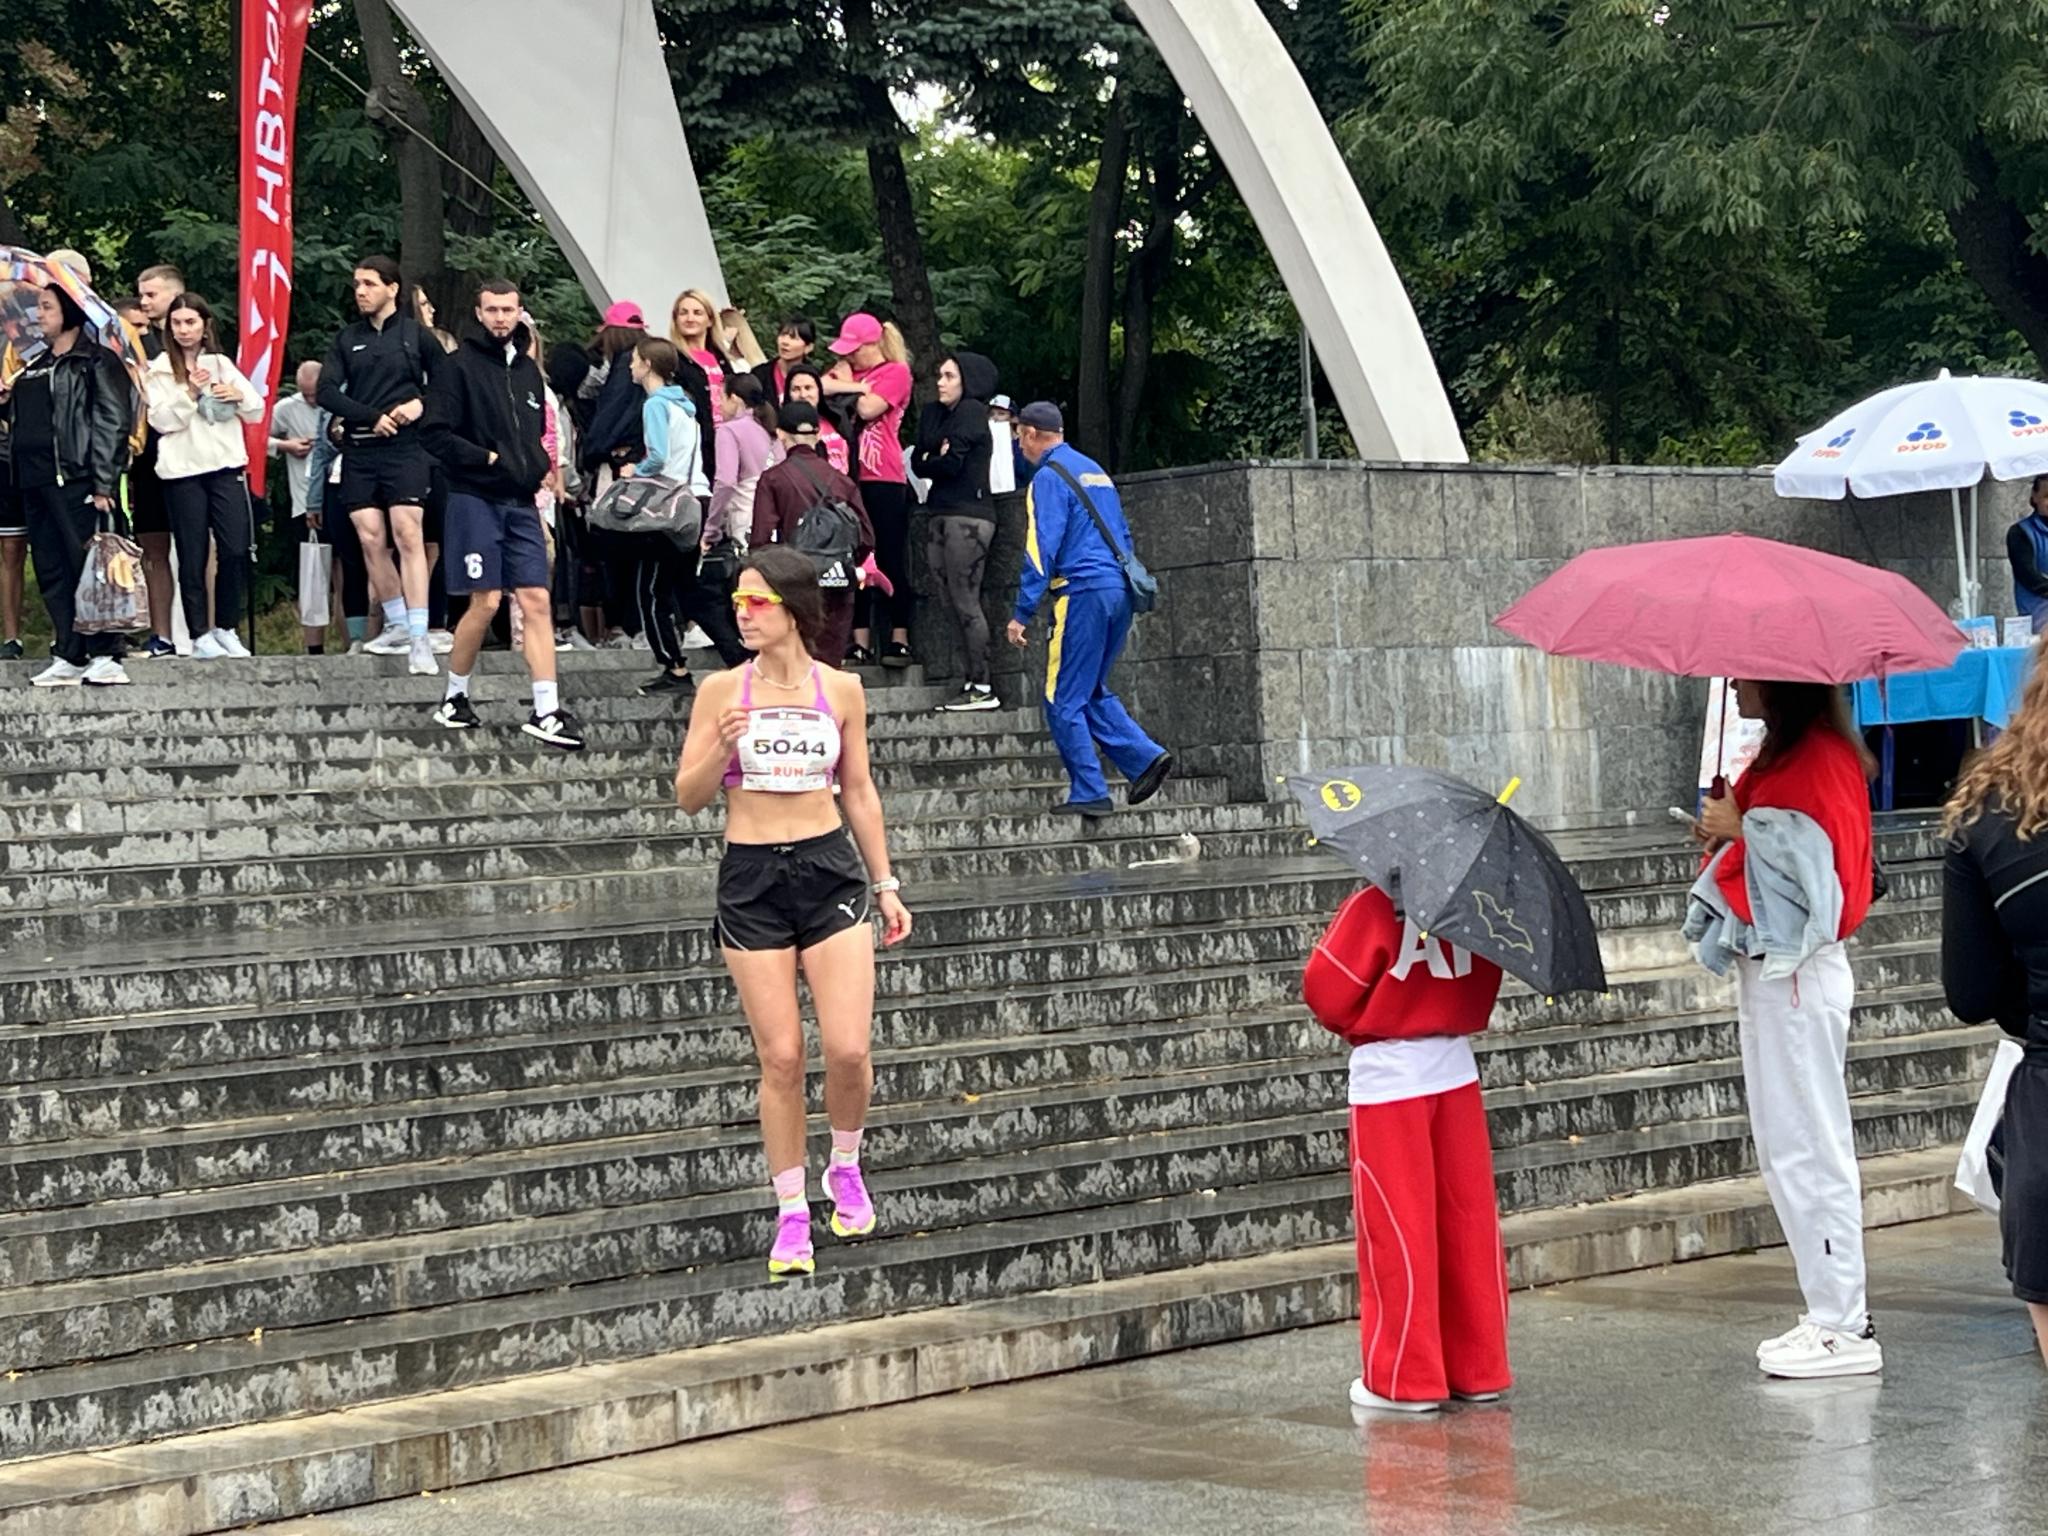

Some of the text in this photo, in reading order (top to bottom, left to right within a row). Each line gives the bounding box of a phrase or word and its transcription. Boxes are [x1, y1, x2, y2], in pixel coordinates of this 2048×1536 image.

[464, 552, 483, 579] 6
[753, 739, 827, 757] 5044
[773, 766, 805, 778] RUN
